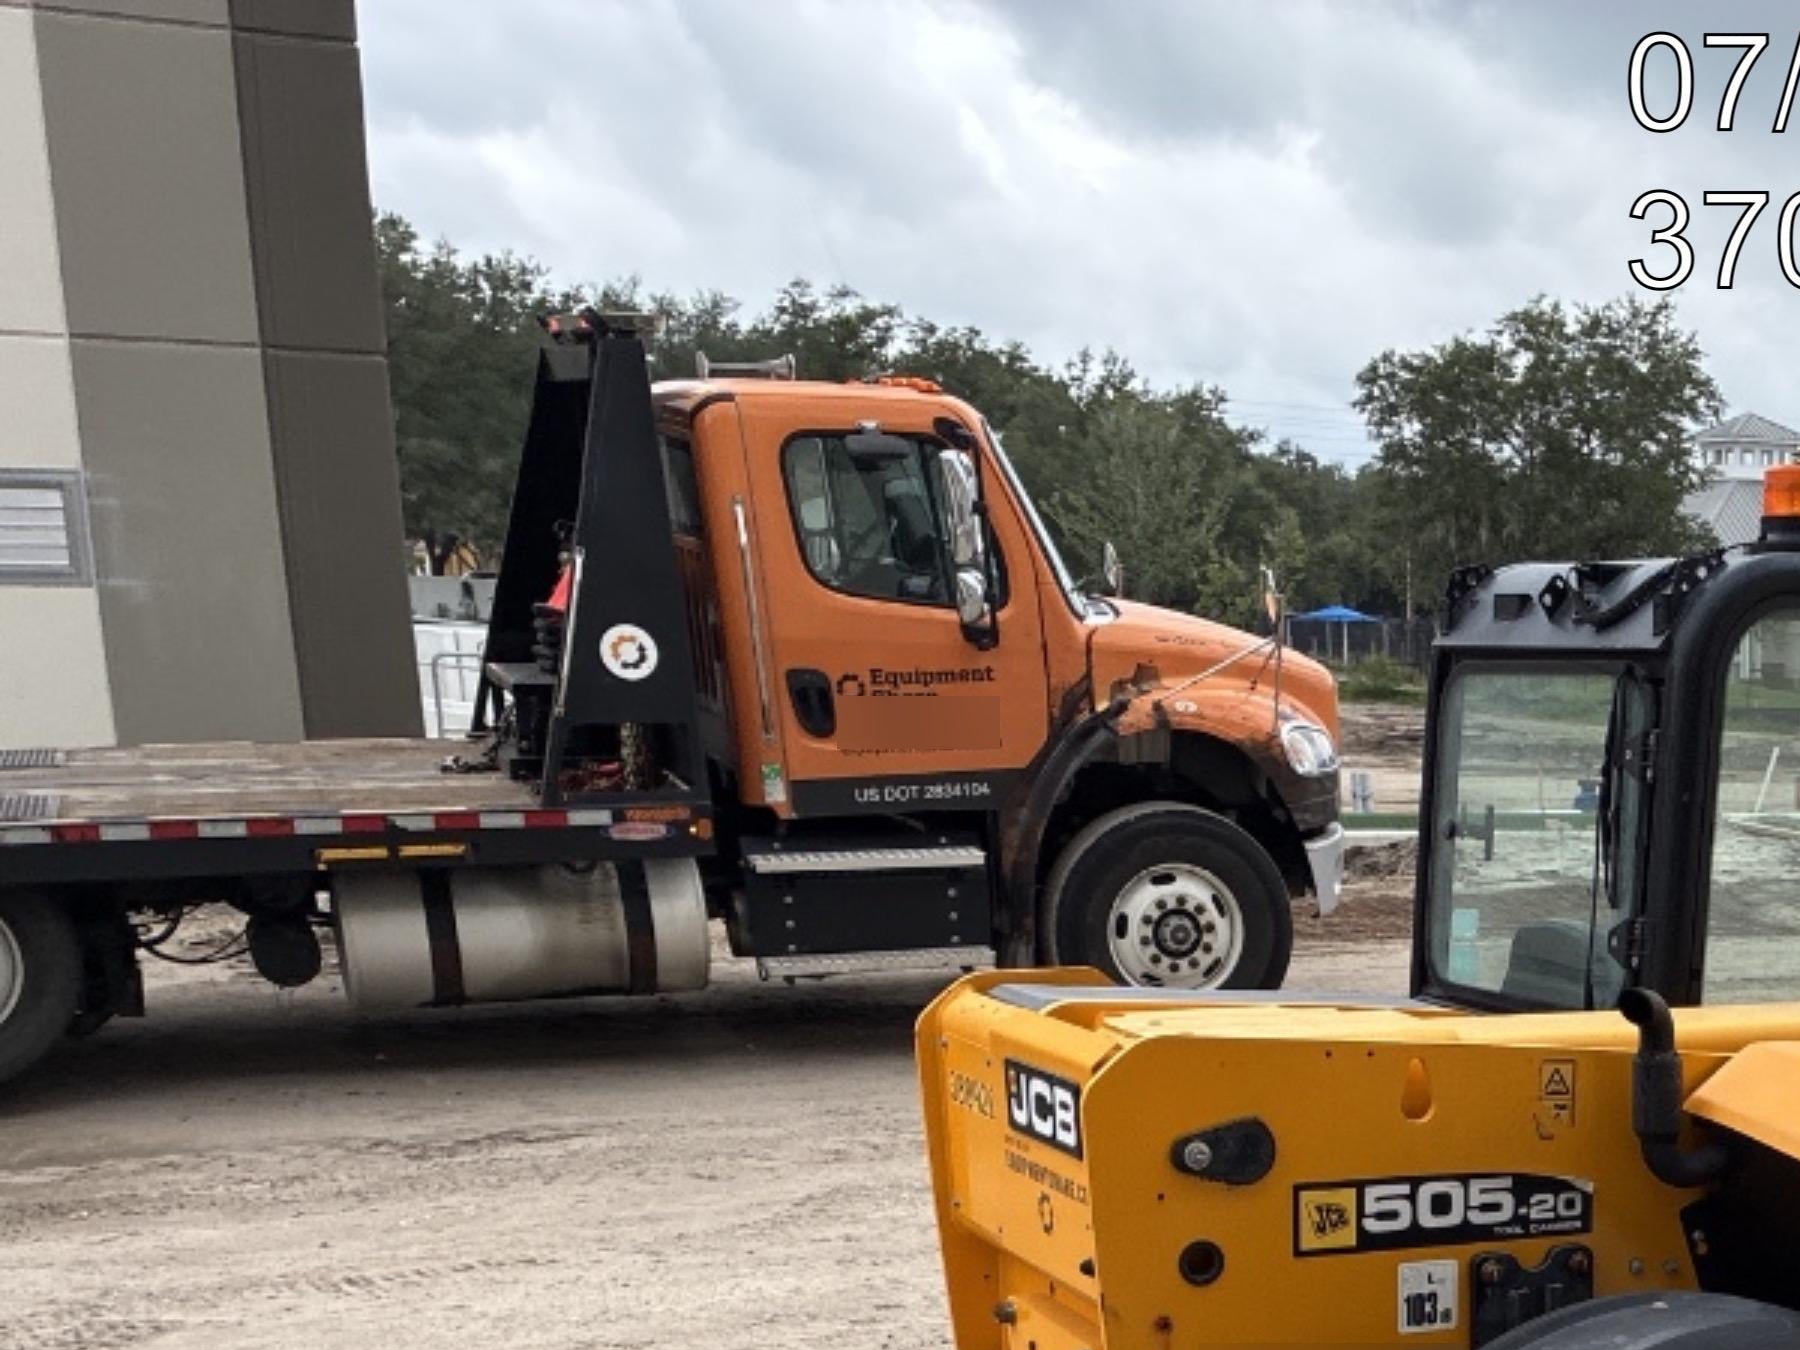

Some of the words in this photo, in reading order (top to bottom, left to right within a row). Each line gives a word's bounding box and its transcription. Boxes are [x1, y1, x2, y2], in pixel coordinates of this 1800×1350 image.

[869, 665, 996, 688] Equipment
[853, 787, 881, 802] US
[883, 785, 920, 802] DOT
[1010, 1072, 1078, 1148] JCB
[1361, 1176, 1583, 1234] 505-20
[1403, 1292, 1438, 1328] 103
